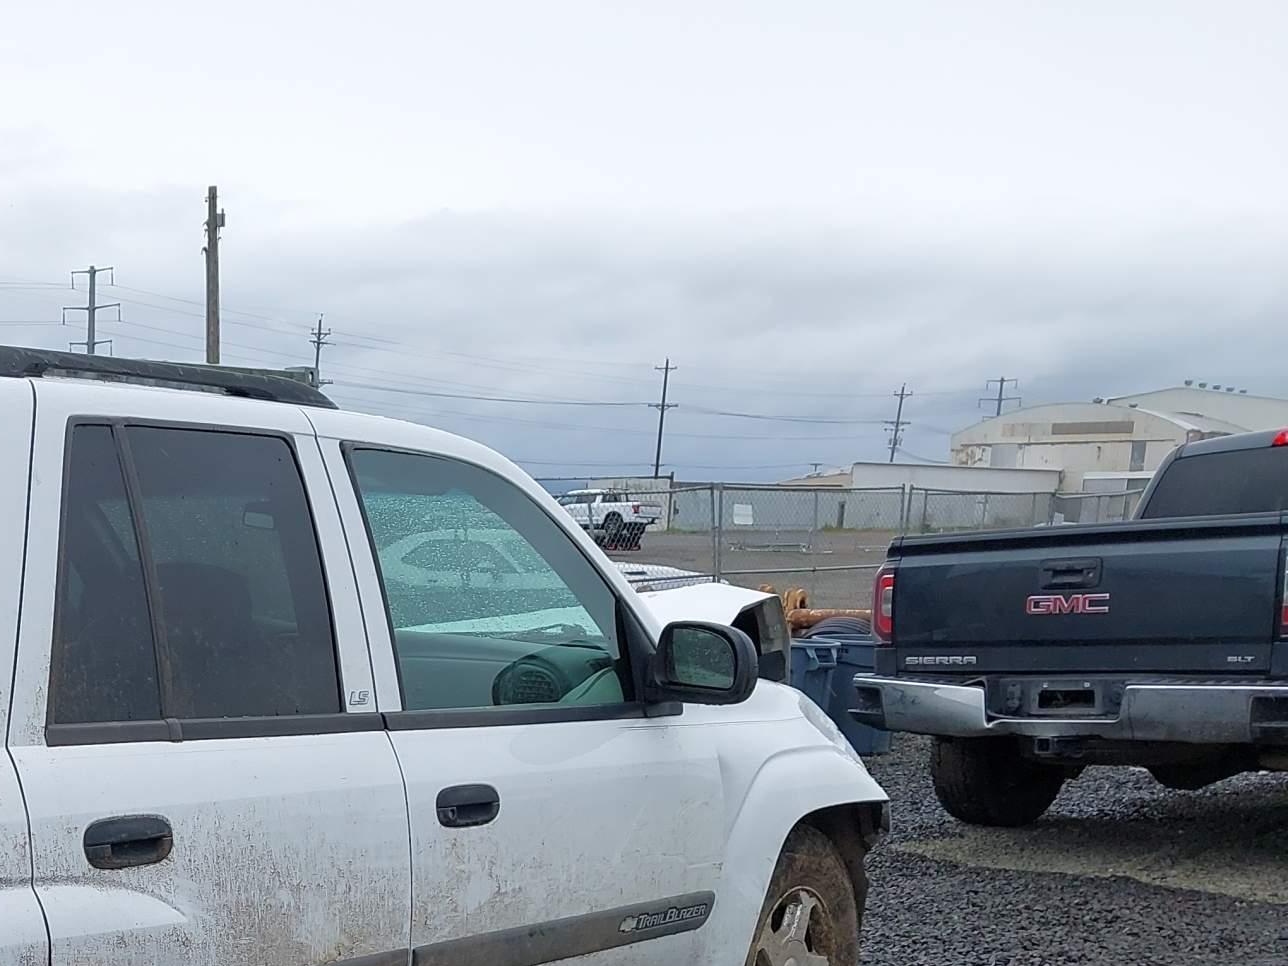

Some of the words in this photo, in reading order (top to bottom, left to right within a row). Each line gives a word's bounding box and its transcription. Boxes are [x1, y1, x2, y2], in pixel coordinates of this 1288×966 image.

[1026, 593, 1110, 615] GMC
[905, 656, 976, 665] SIERRA
[1227, 655, 1256, 663] SLT
[349, 690, 369, 706] LS
